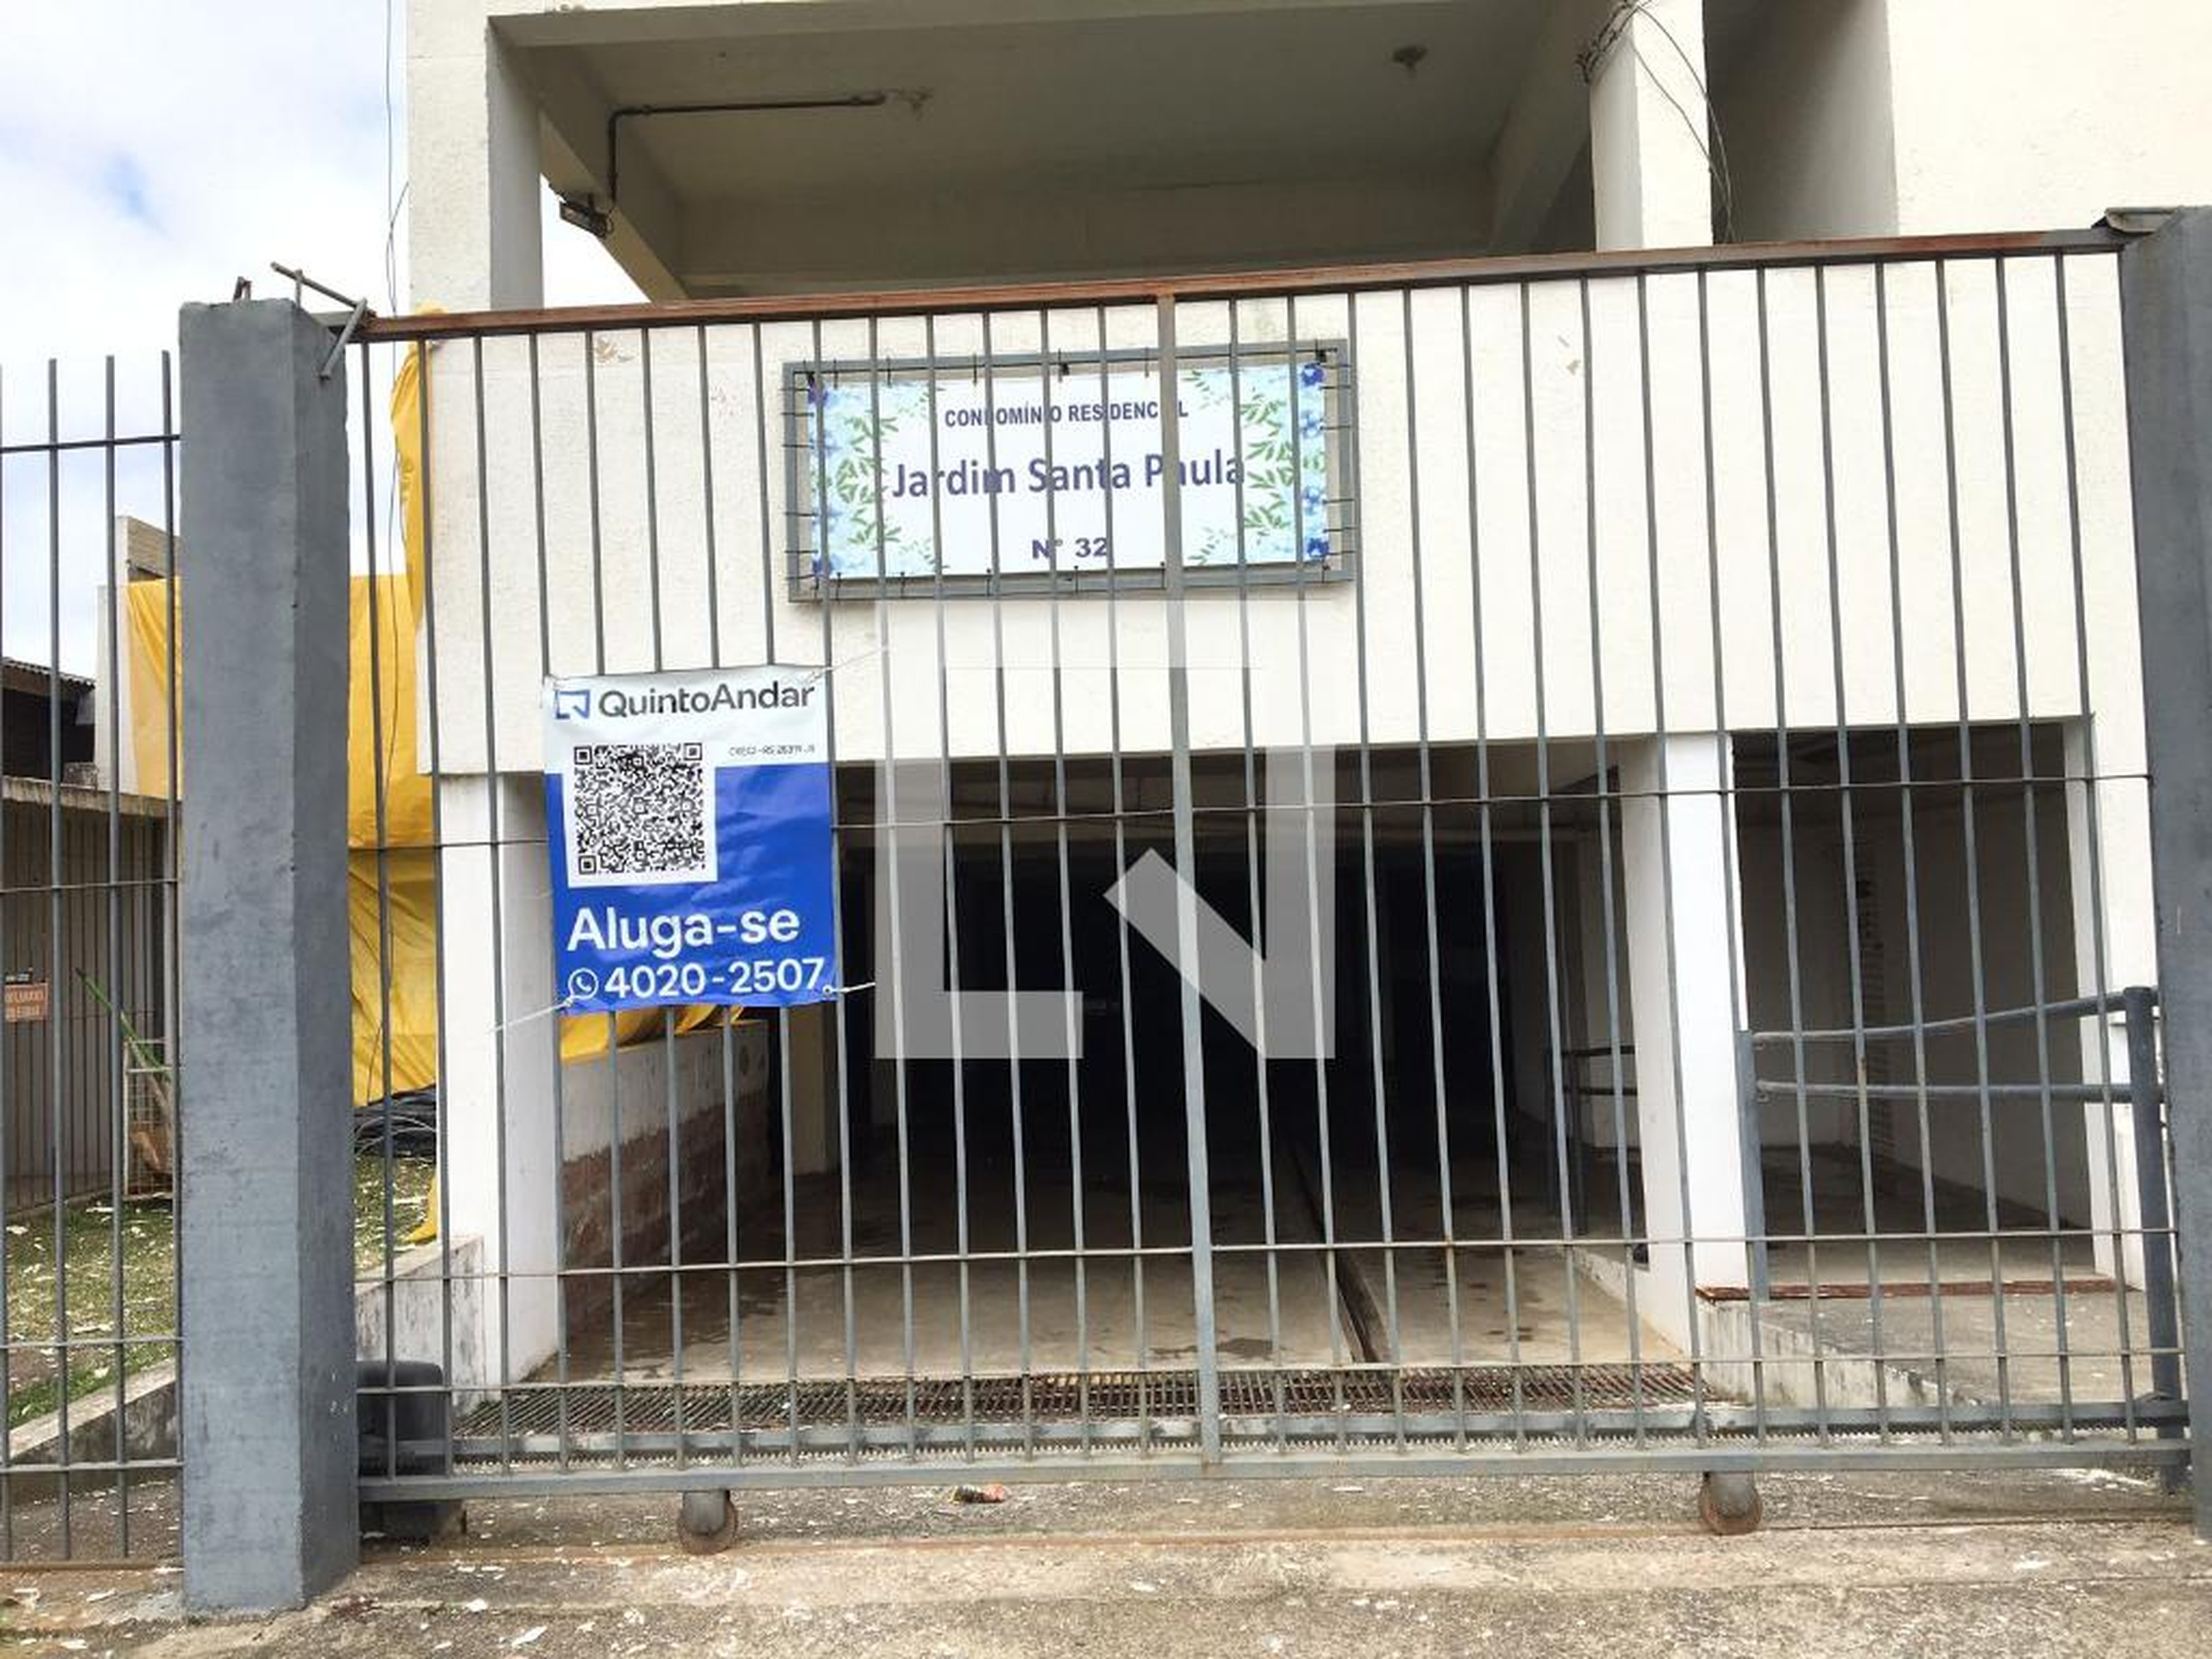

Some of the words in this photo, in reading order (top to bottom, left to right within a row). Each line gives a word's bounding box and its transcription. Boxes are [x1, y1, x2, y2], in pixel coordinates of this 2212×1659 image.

[945, 401, 1062, 427] CONOMÍNO
[1069, 400, 1189, 423] RESDENCL
[1028, 458, 1131, 493] Santa
[1074, 536, 1109, 558] 32
[598, 680, 816, 718] QuintoAndar
[567, 906, 800, 959] Aluga-se
[604, 957, 825, 999] 4020-2507
